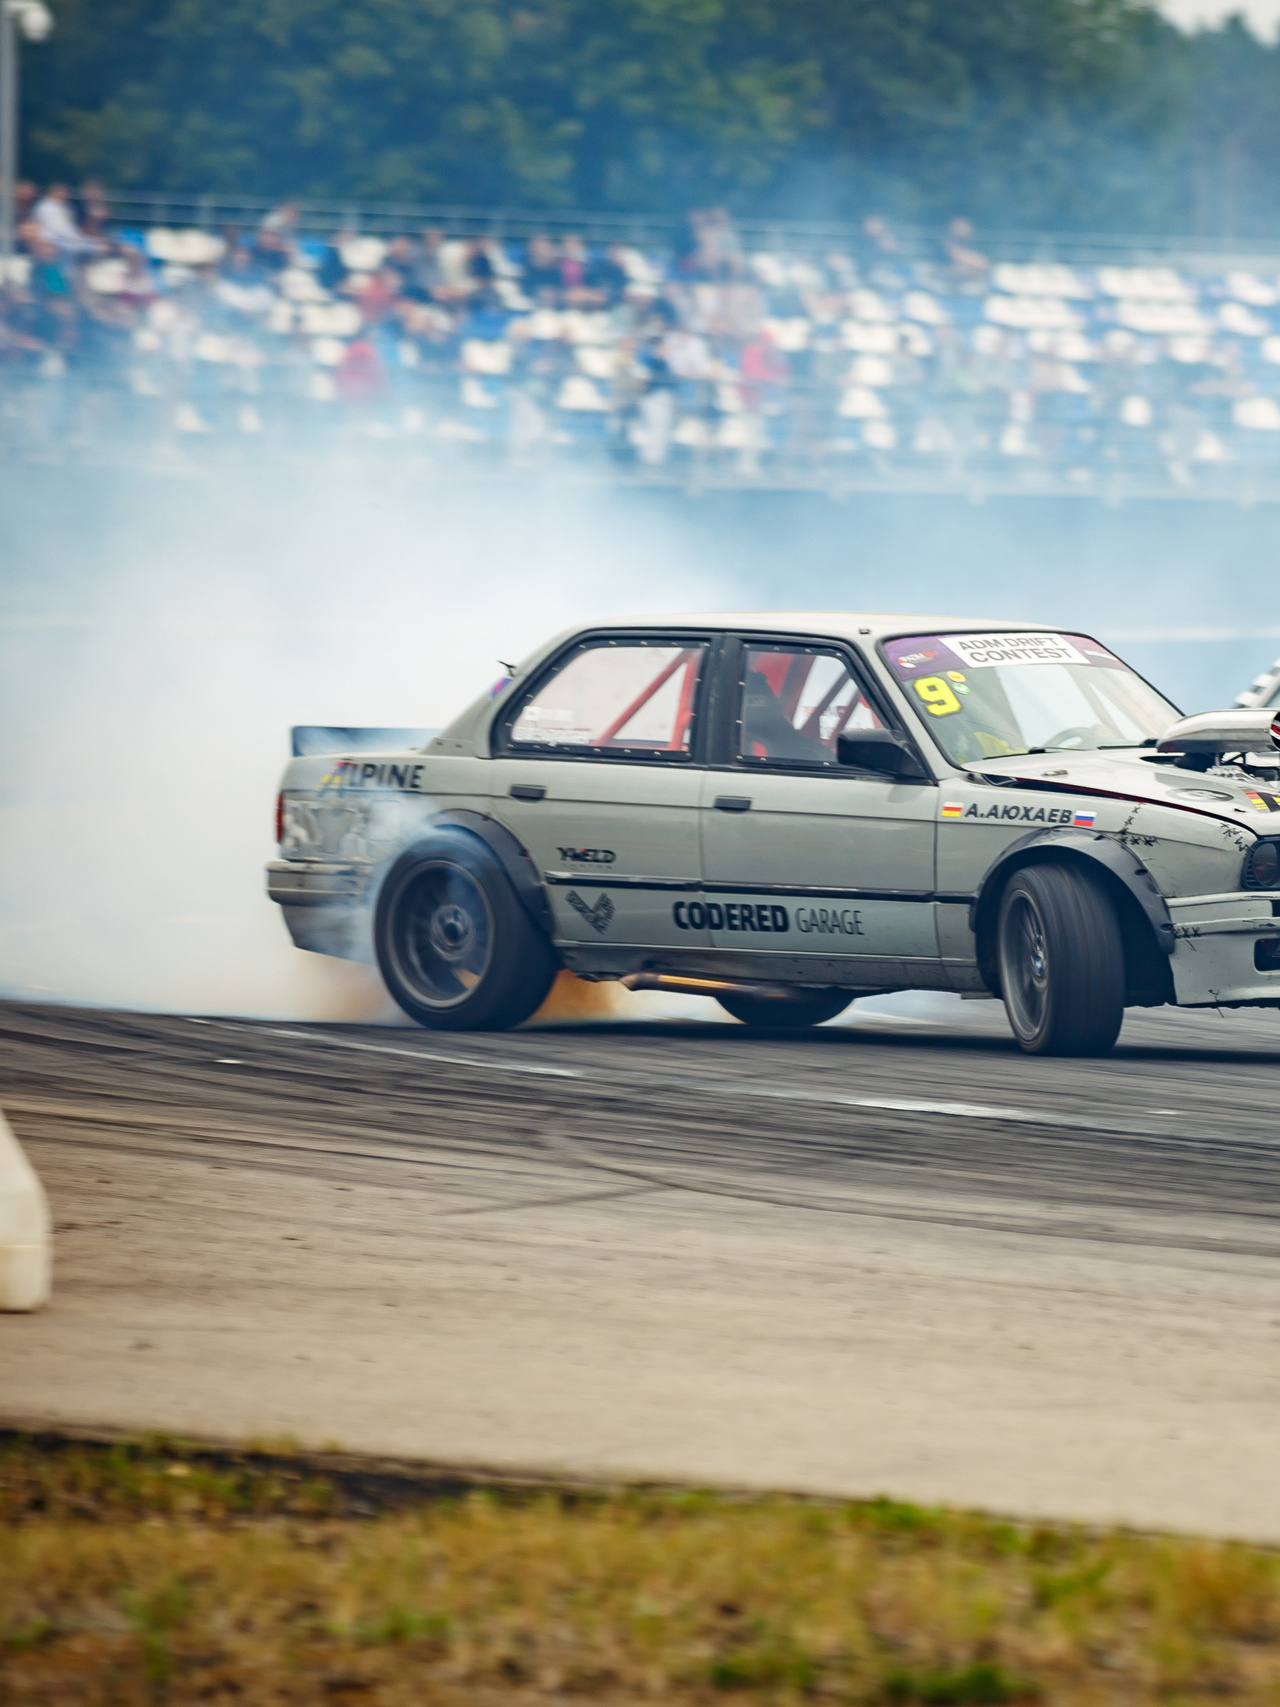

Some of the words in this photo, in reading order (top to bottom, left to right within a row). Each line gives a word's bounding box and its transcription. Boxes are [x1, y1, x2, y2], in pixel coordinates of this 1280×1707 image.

[958, 639, 1003, 651] ADM
[1005, 637, 1056, 648] DRIFT
[969, 648, 1072, 663] CONTEST
[913, 676, 962, 718] 9
[964, 803, 1072, 824] А.АЮХАЕВ
[673, 901, 790, 932] CODERED
[795, 907, 865, 936] GARAGE
